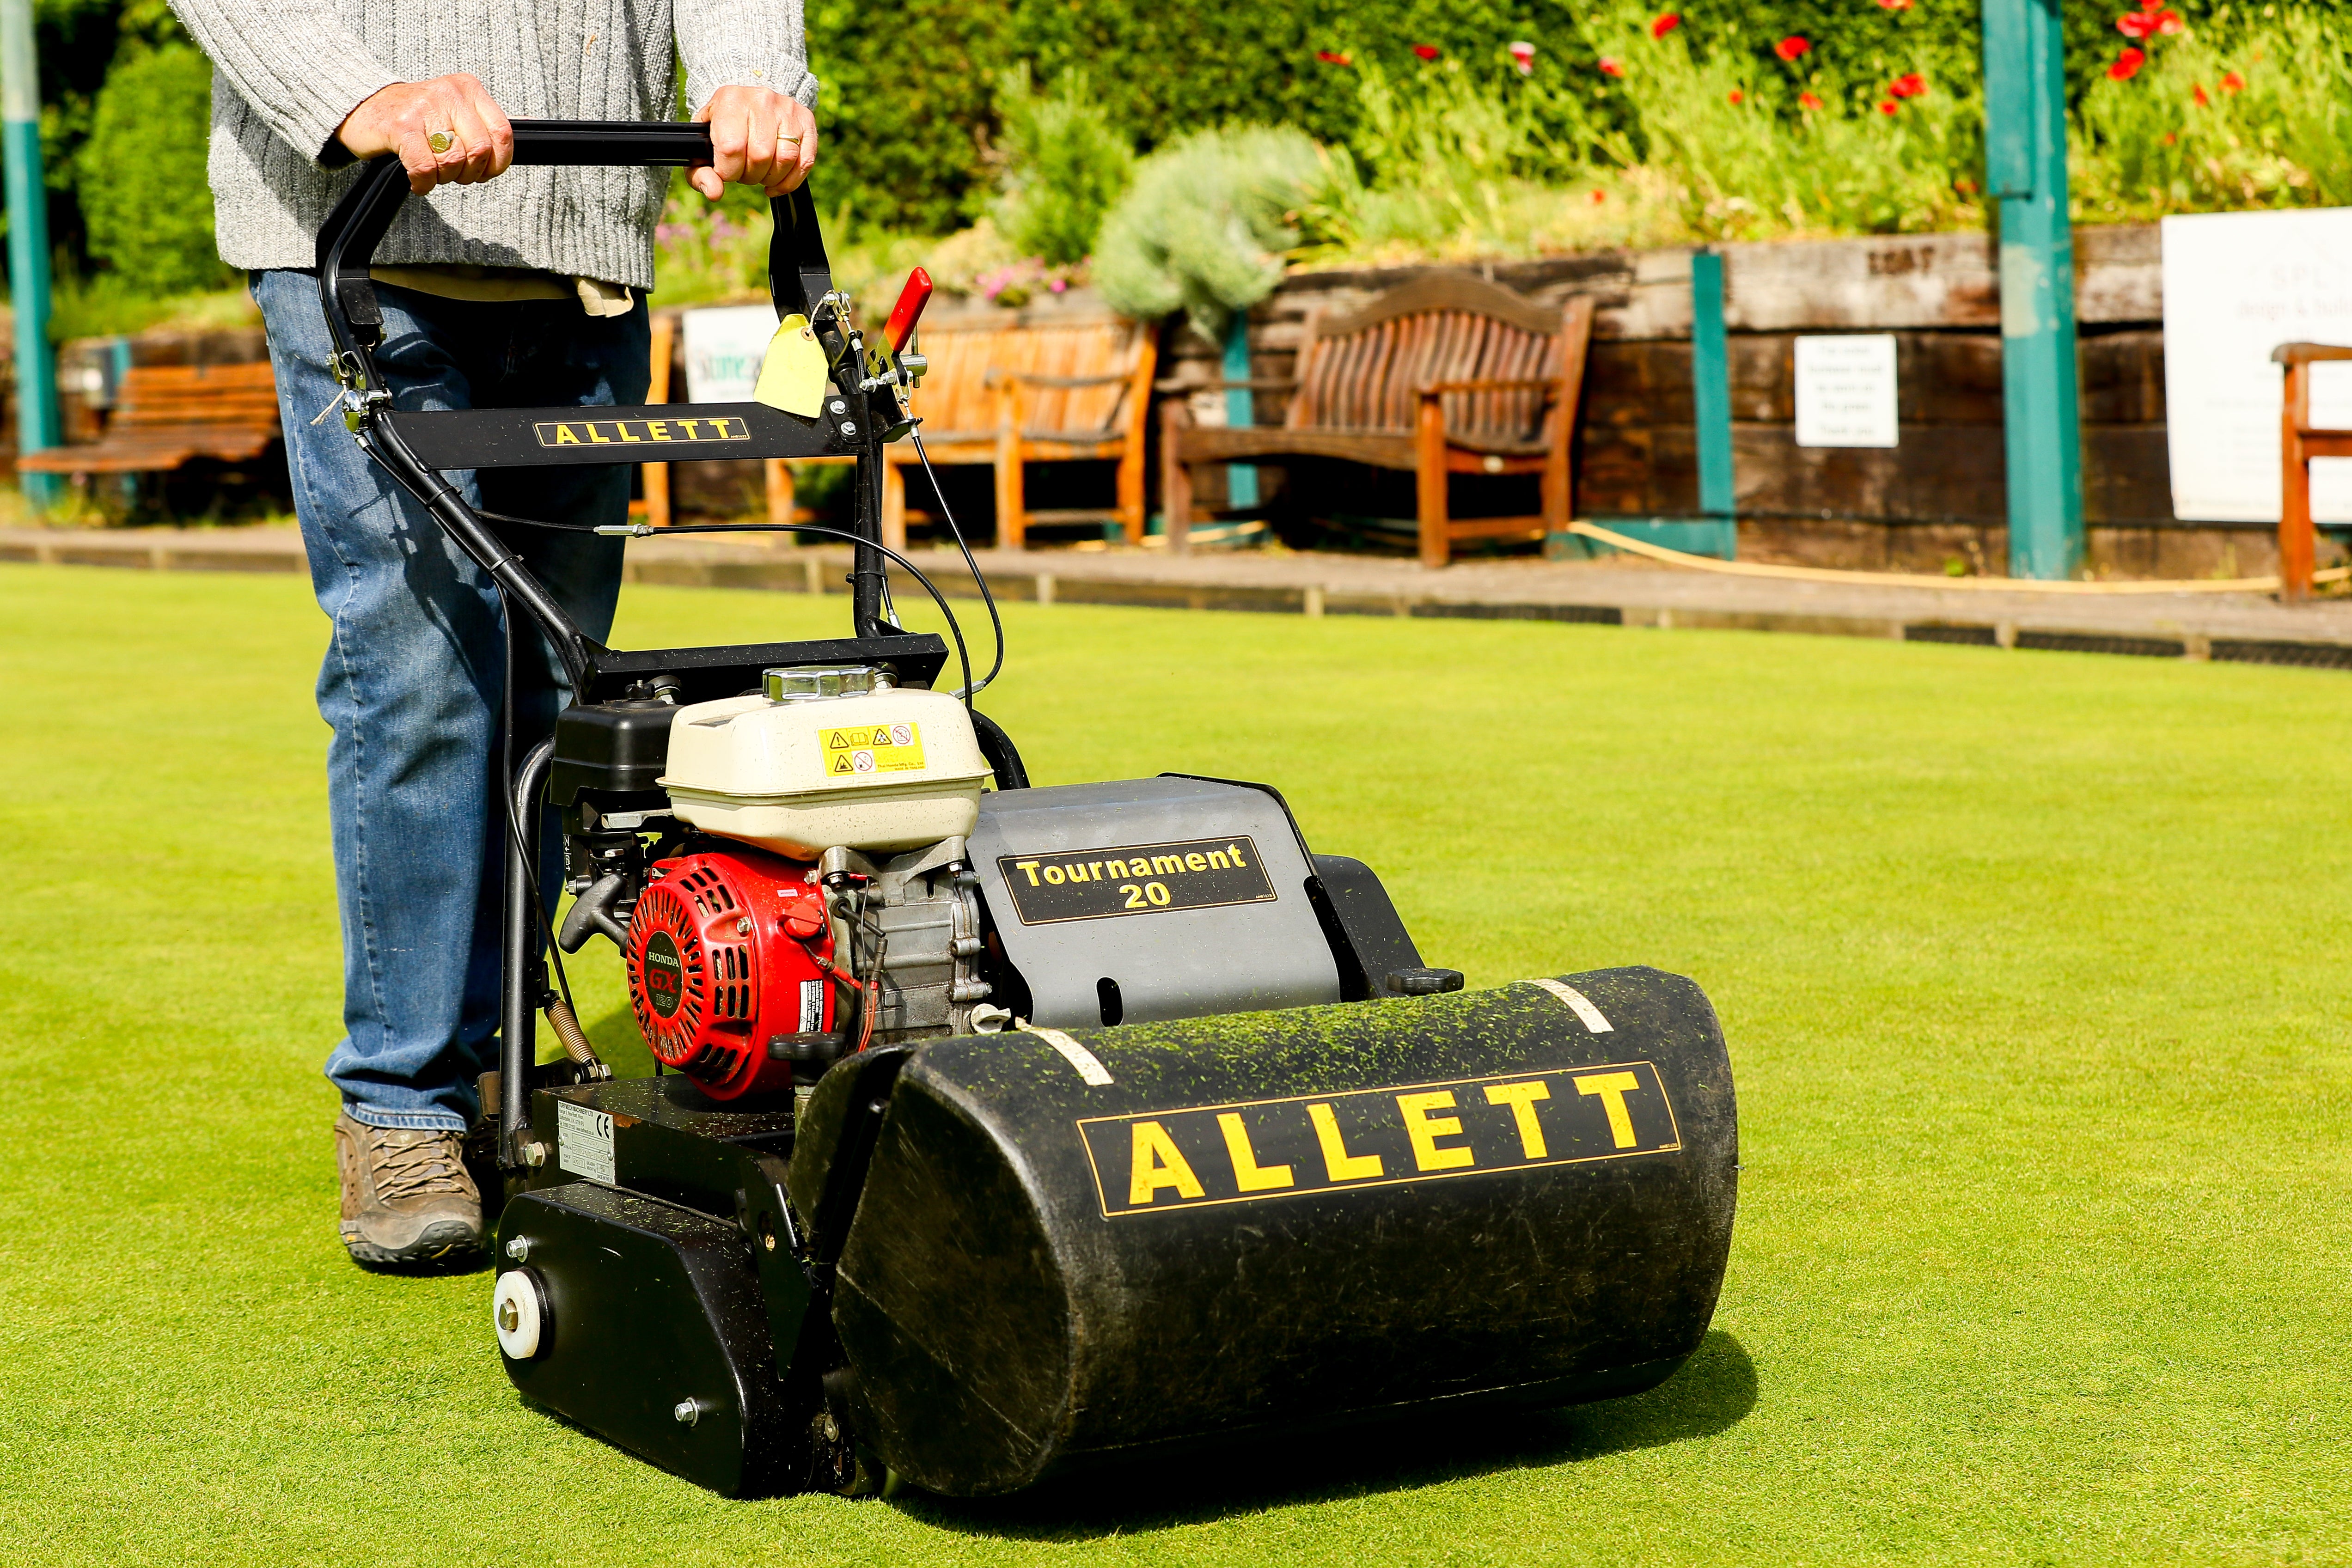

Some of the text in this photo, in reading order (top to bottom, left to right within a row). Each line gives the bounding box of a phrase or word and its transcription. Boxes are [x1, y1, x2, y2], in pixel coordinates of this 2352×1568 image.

[556, 420, 730, 444] ALLETT
[1016, 842, 1247, 887] Tournament
[1119, 882, 1172, 909] 20
[648, 952, 679, 967] HONDA
[649, 969, 678, 993] GX
[656, 994, 673, 1008] 120
[1129, 1071, 1640, 1205] ALLETT
